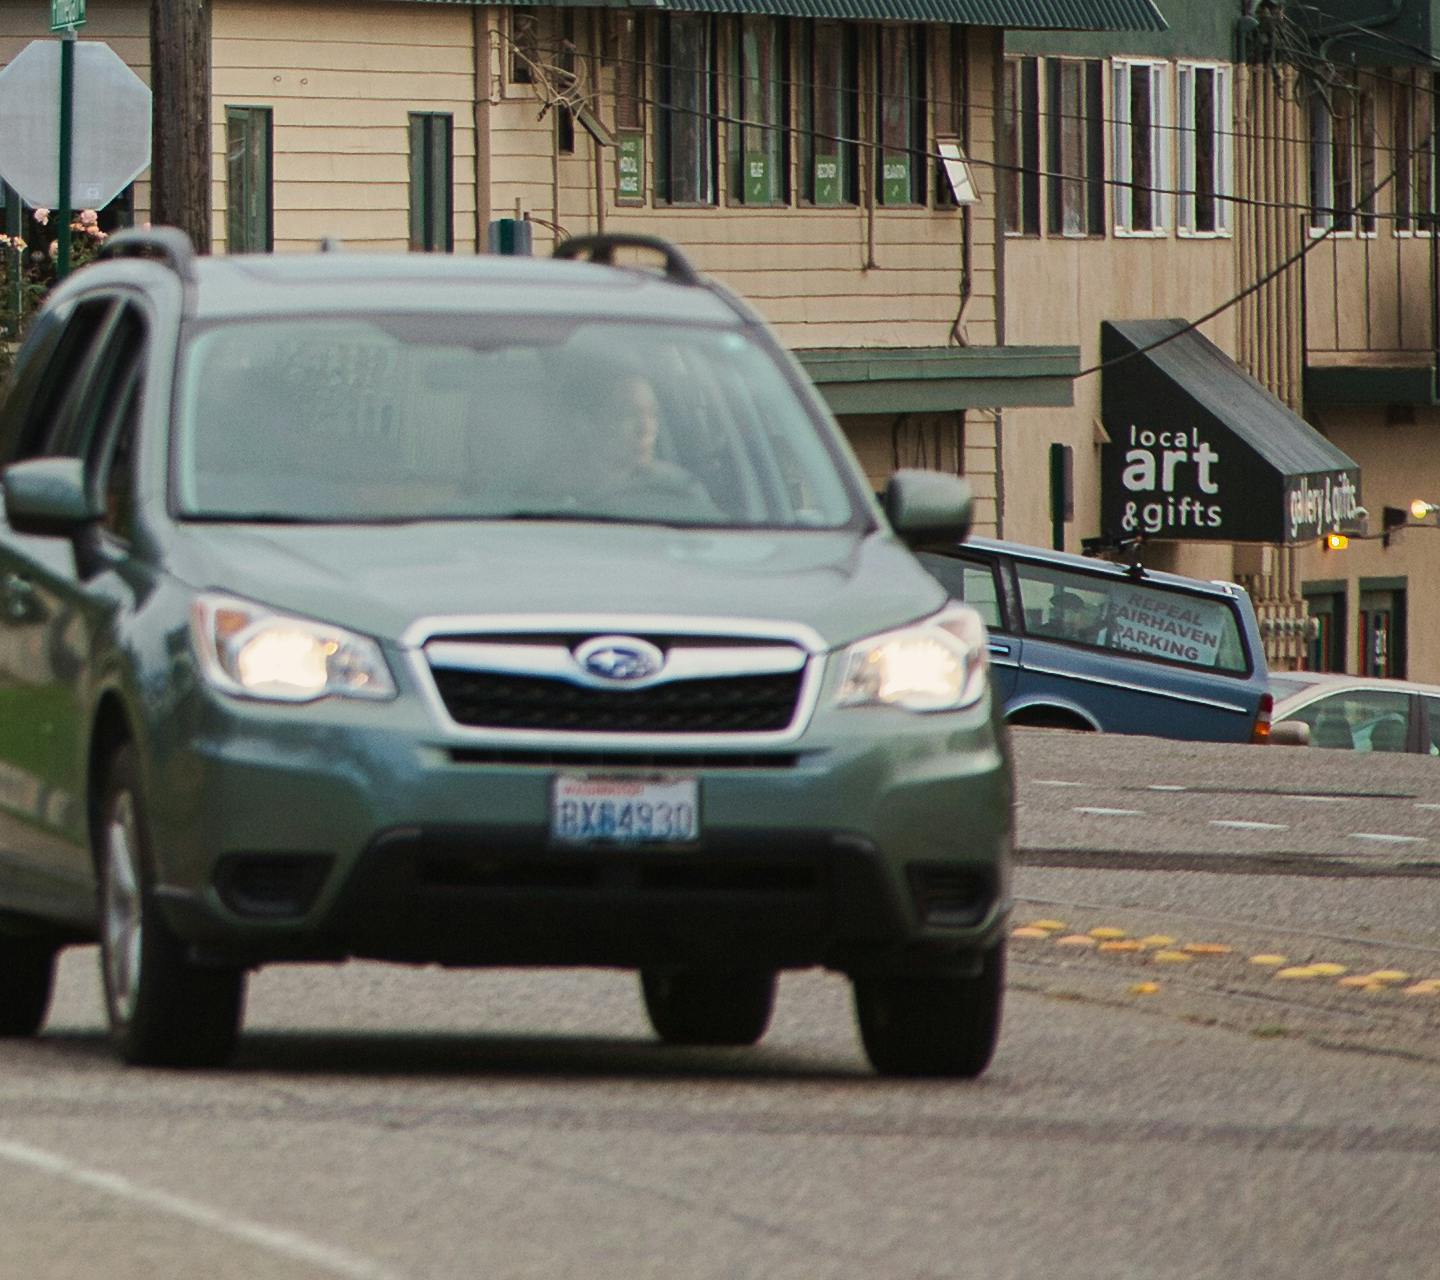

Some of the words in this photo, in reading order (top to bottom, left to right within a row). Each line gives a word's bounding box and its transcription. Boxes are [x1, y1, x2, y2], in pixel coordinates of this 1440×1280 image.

[1130, 424, 1198, 448] local
[1122, 442, 1219, 494] art
[1110, 603, 1218, 648] FAIRHAVEN
[1128, 593, 1202, 626] REPEAL
[1113, 622, 1199, 661] PARKING
